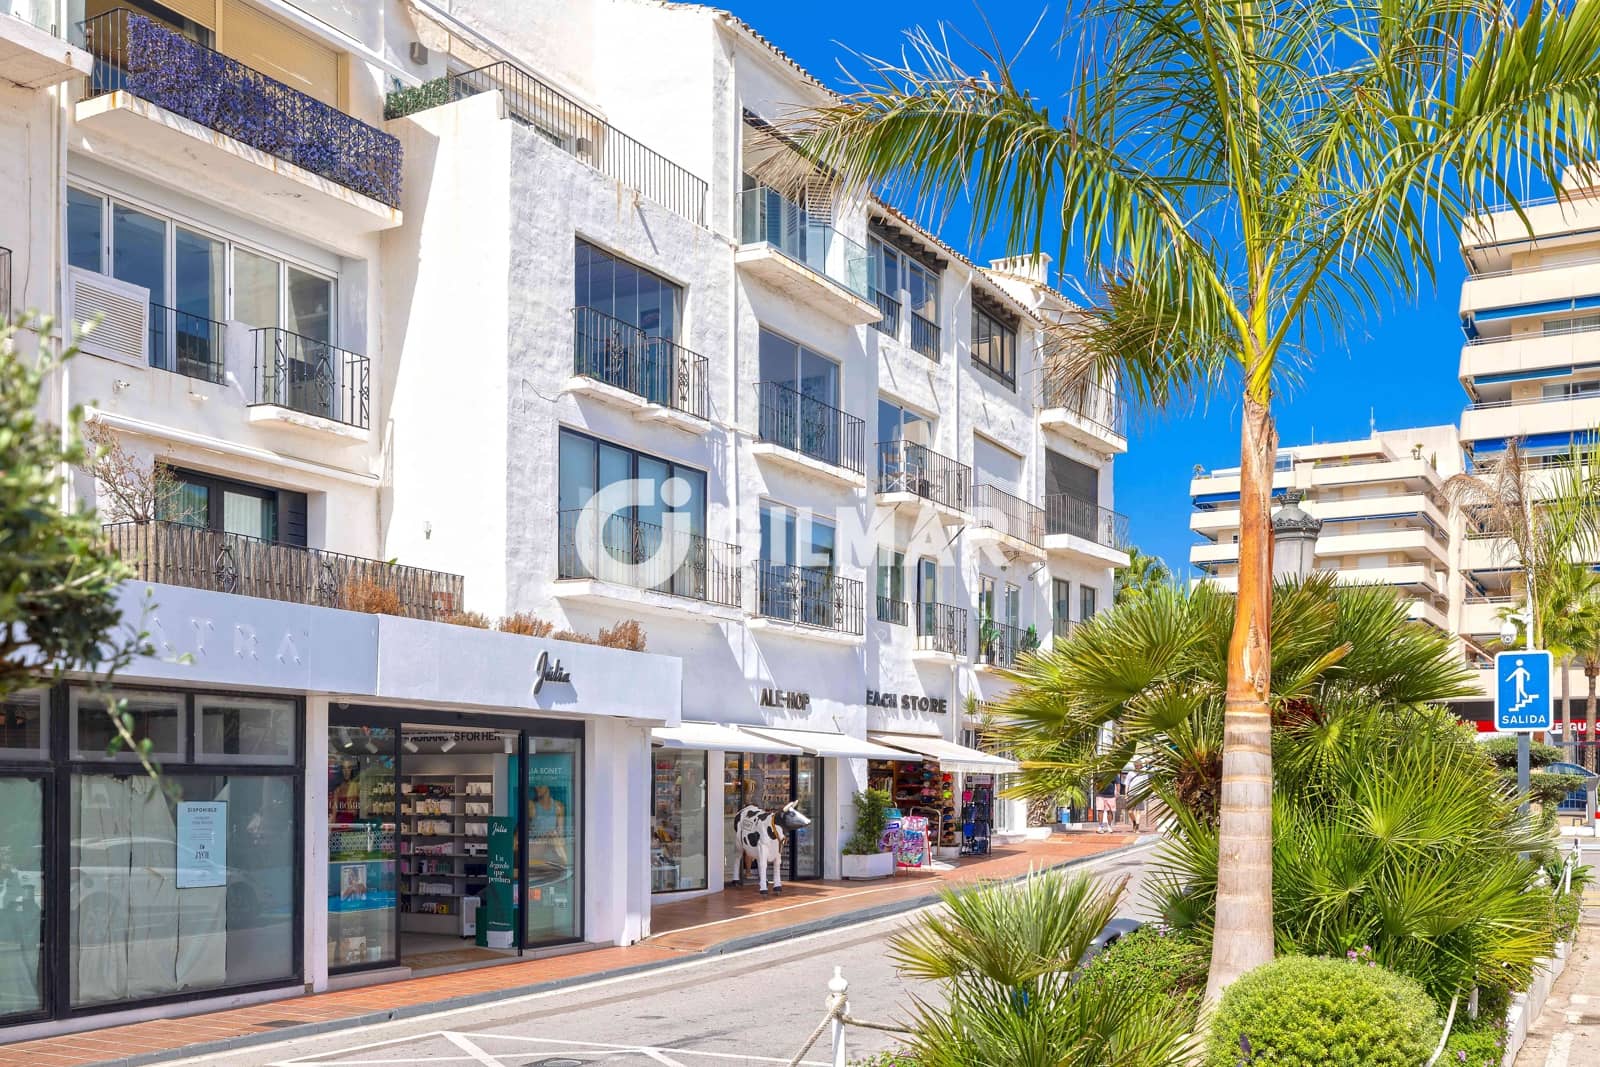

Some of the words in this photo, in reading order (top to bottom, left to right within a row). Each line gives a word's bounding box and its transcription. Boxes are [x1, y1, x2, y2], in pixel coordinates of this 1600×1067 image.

[760, 688, 810, 711] ALE-HOP
[866, 690, 898, 709] EACH
[901, 694, 947, 714] STORE
[1502, 715, 1546, 724] SALIDA
[461, 731, 480, 741] FOR
